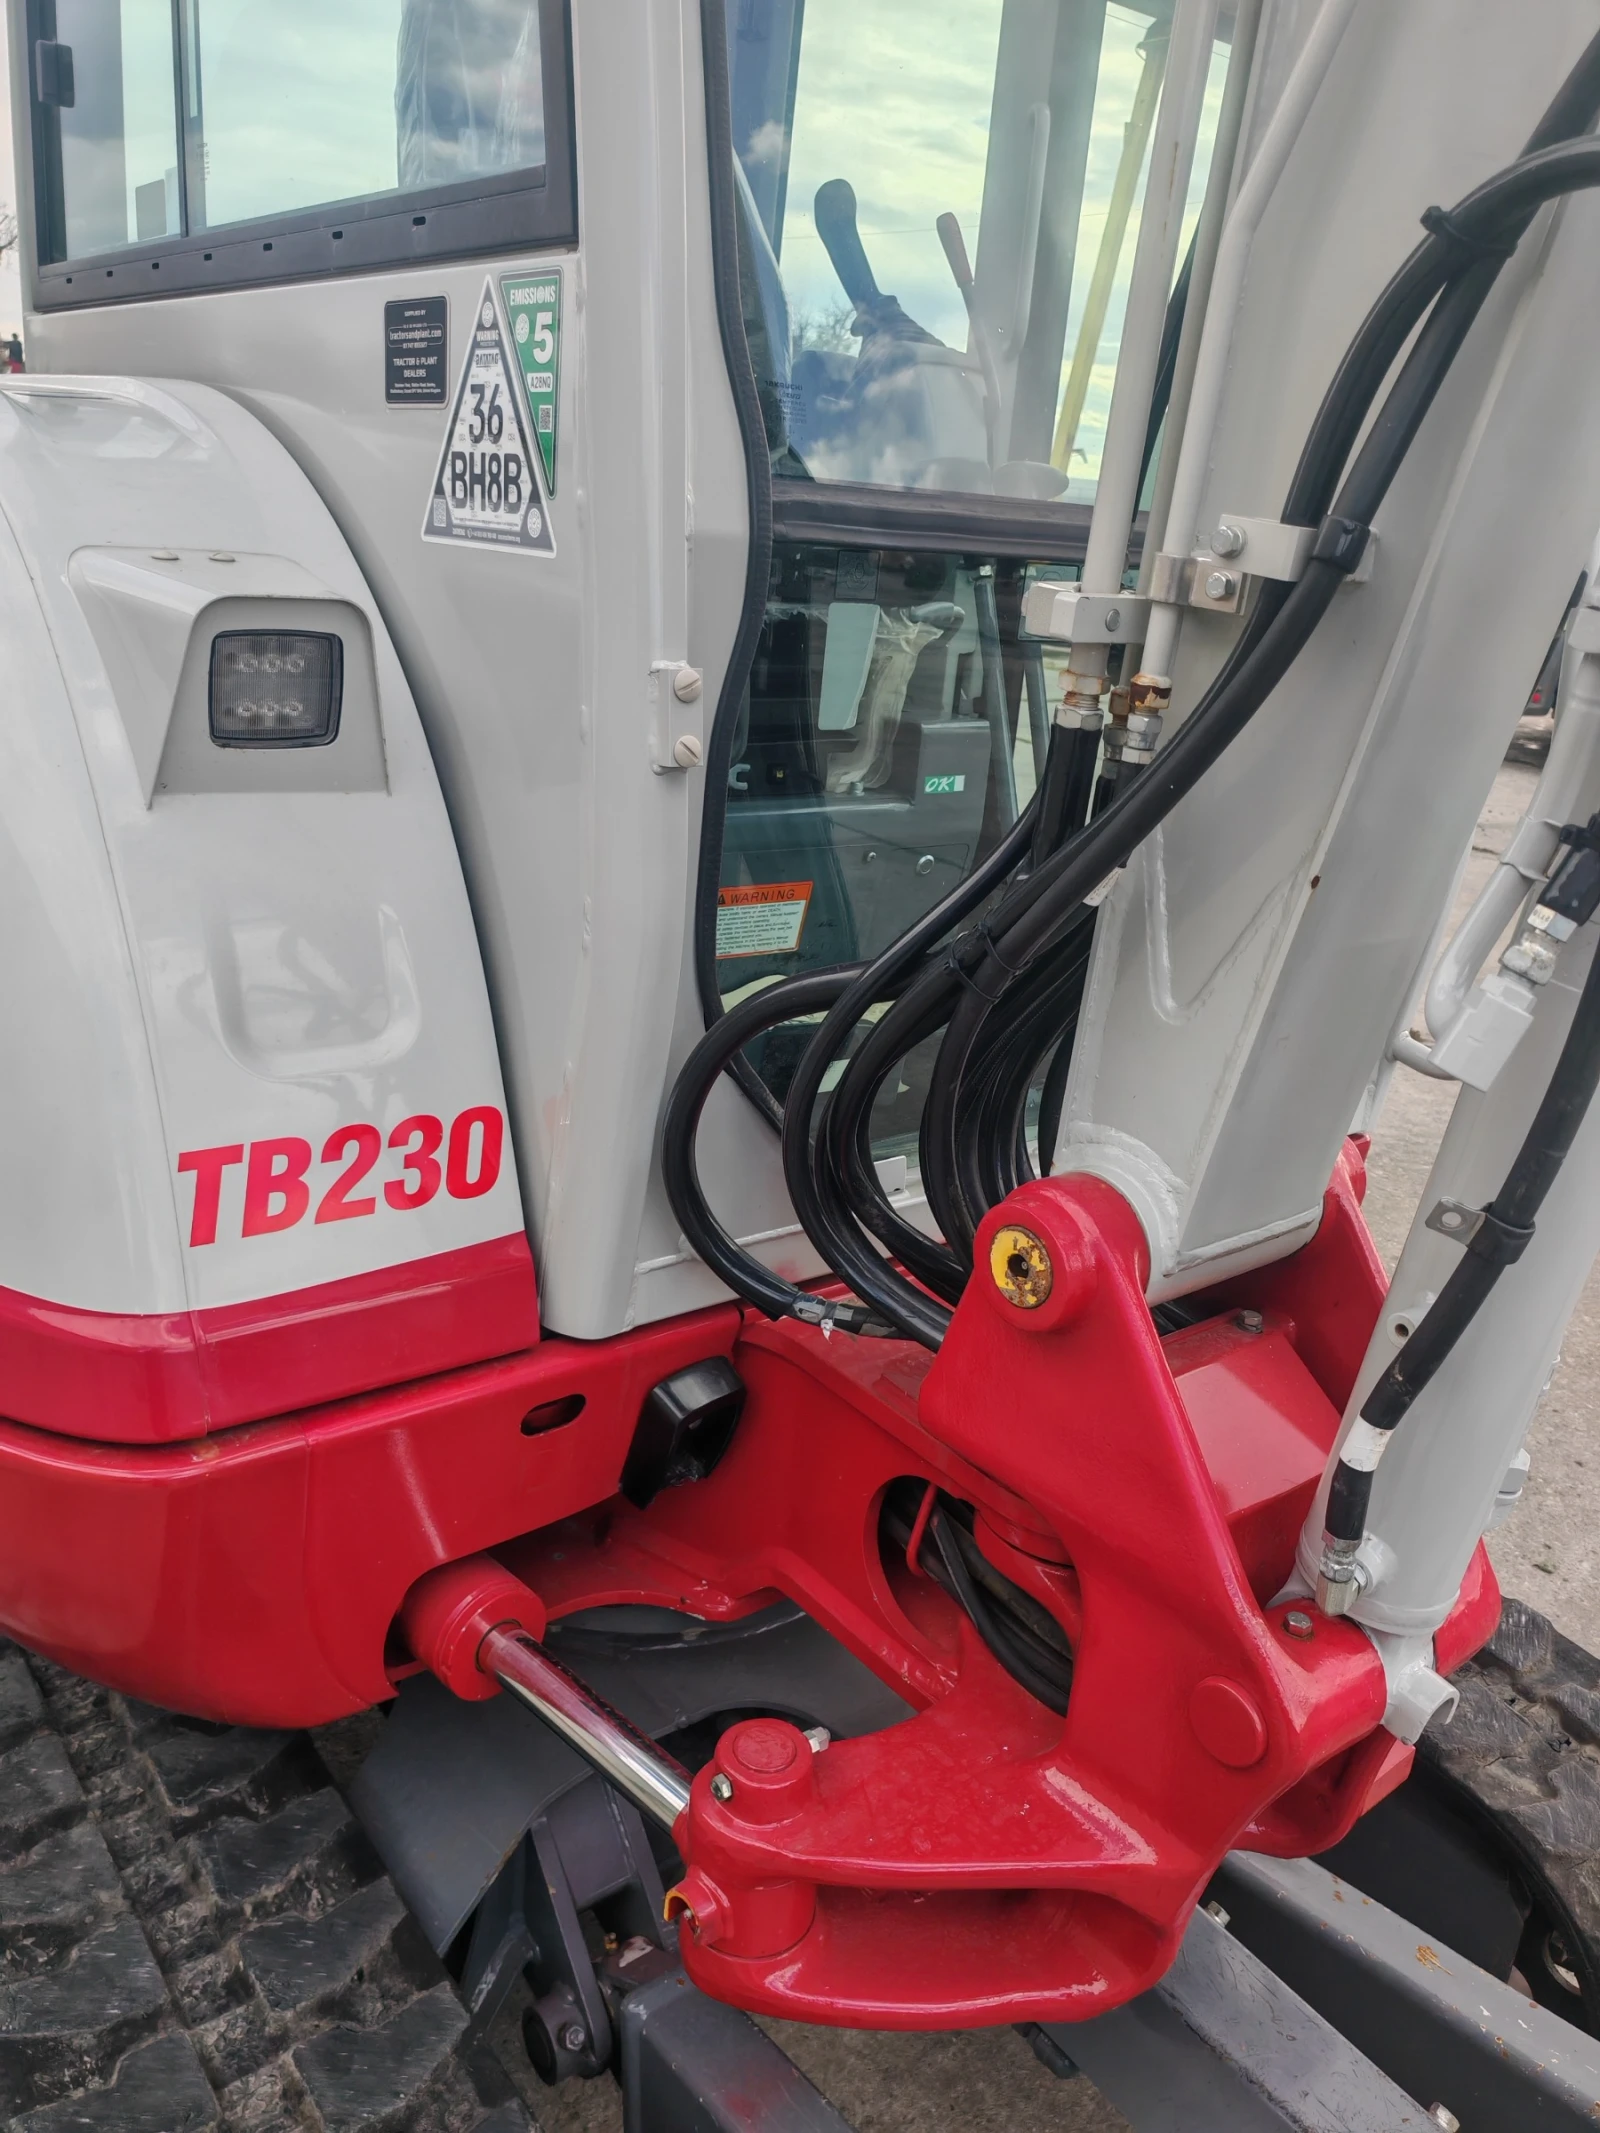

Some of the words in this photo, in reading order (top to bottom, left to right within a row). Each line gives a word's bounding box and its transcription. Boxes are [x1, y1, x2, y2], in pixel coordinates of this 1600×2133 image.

[510, 285, 556, 306] EMISSIONS
[389, 329, 442, 341] tractorsandplant.com
[476, 329, 499, 342] WARNING
[532, 311, 554, 364] 5
[393, 358, 416, 366] TRACTOR
[420, 356, 438, 366] PLANT
[403, 369, 427, 378] DEALERS
[469, 383, 504, 445] 36
[451, 451, 522, 515] BH8B
[925, 776, 955, 793] OK
[730, 889, 795, 904] WARNING
[177, 1105, 504, 1248] TB230
